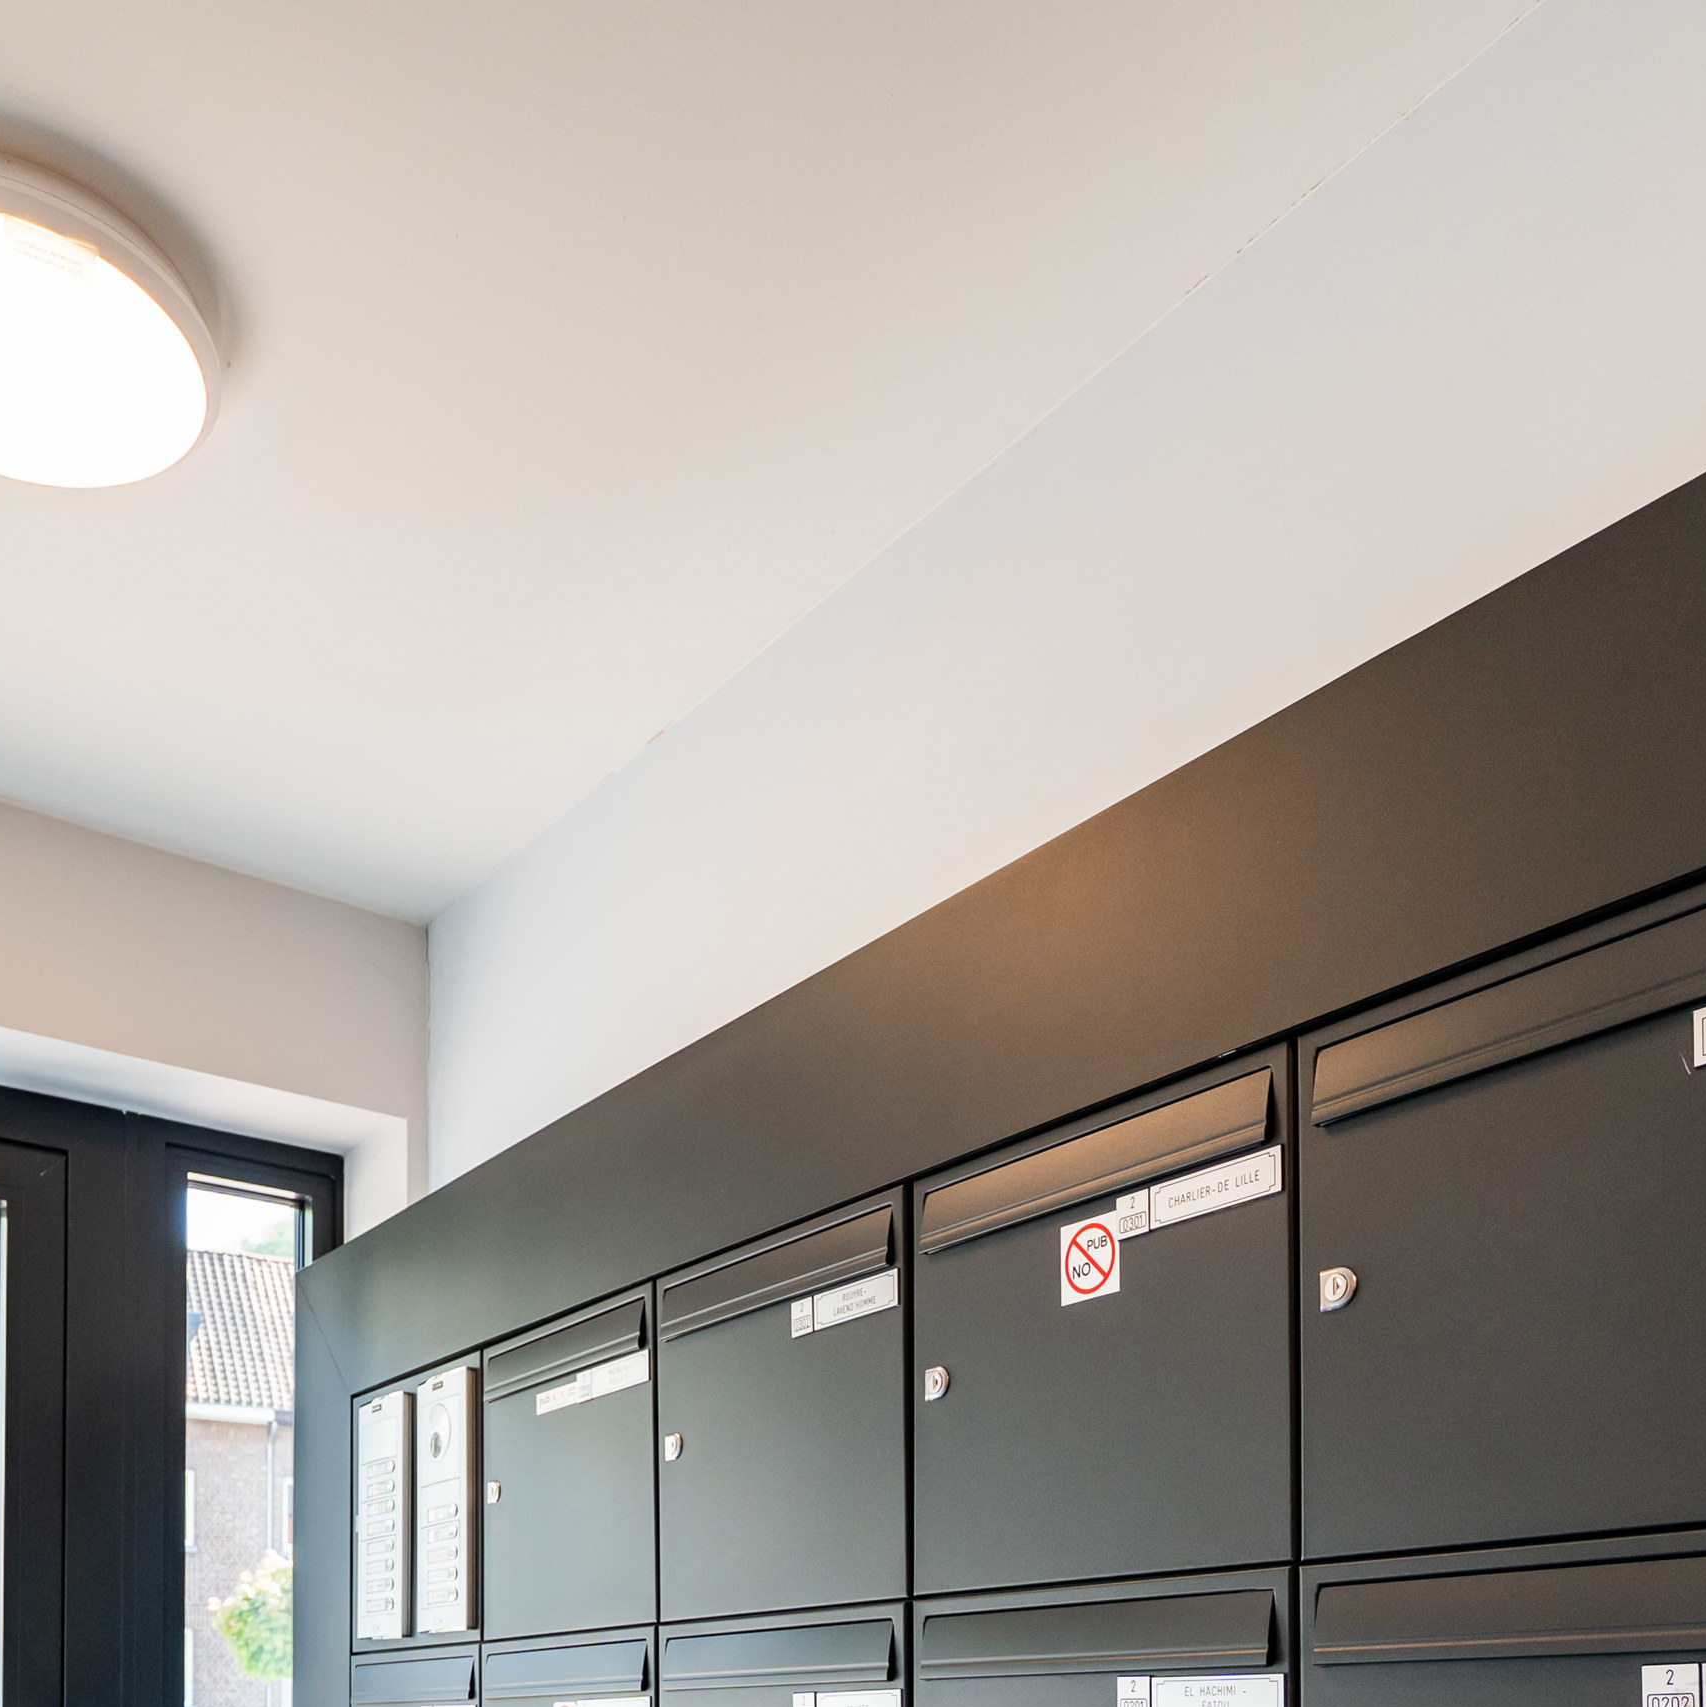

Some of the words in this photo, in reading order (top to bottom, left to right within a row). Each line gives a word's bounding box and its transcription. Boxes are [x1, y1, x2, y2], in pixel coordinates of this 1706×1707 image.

[1168, 1179, 1230, 1208] CHARLIER-DE
[1235, 1169, 1260, 1188] LILLE
[1130, 1196, 1136, 1209] 2
[1123, 1214, 1143, 1232] 0301
[1087, 1235, 1108, 1251] PUB
[1073, 1262, 1091, 1279] NO
[1665, 1669, 1674, 1686] 2
[1131, 1680, 1136, 1693] 2
[1184, 1686, 1195, 1697] EL
[1199, 1685, 1237, 1697] HACHIMI
